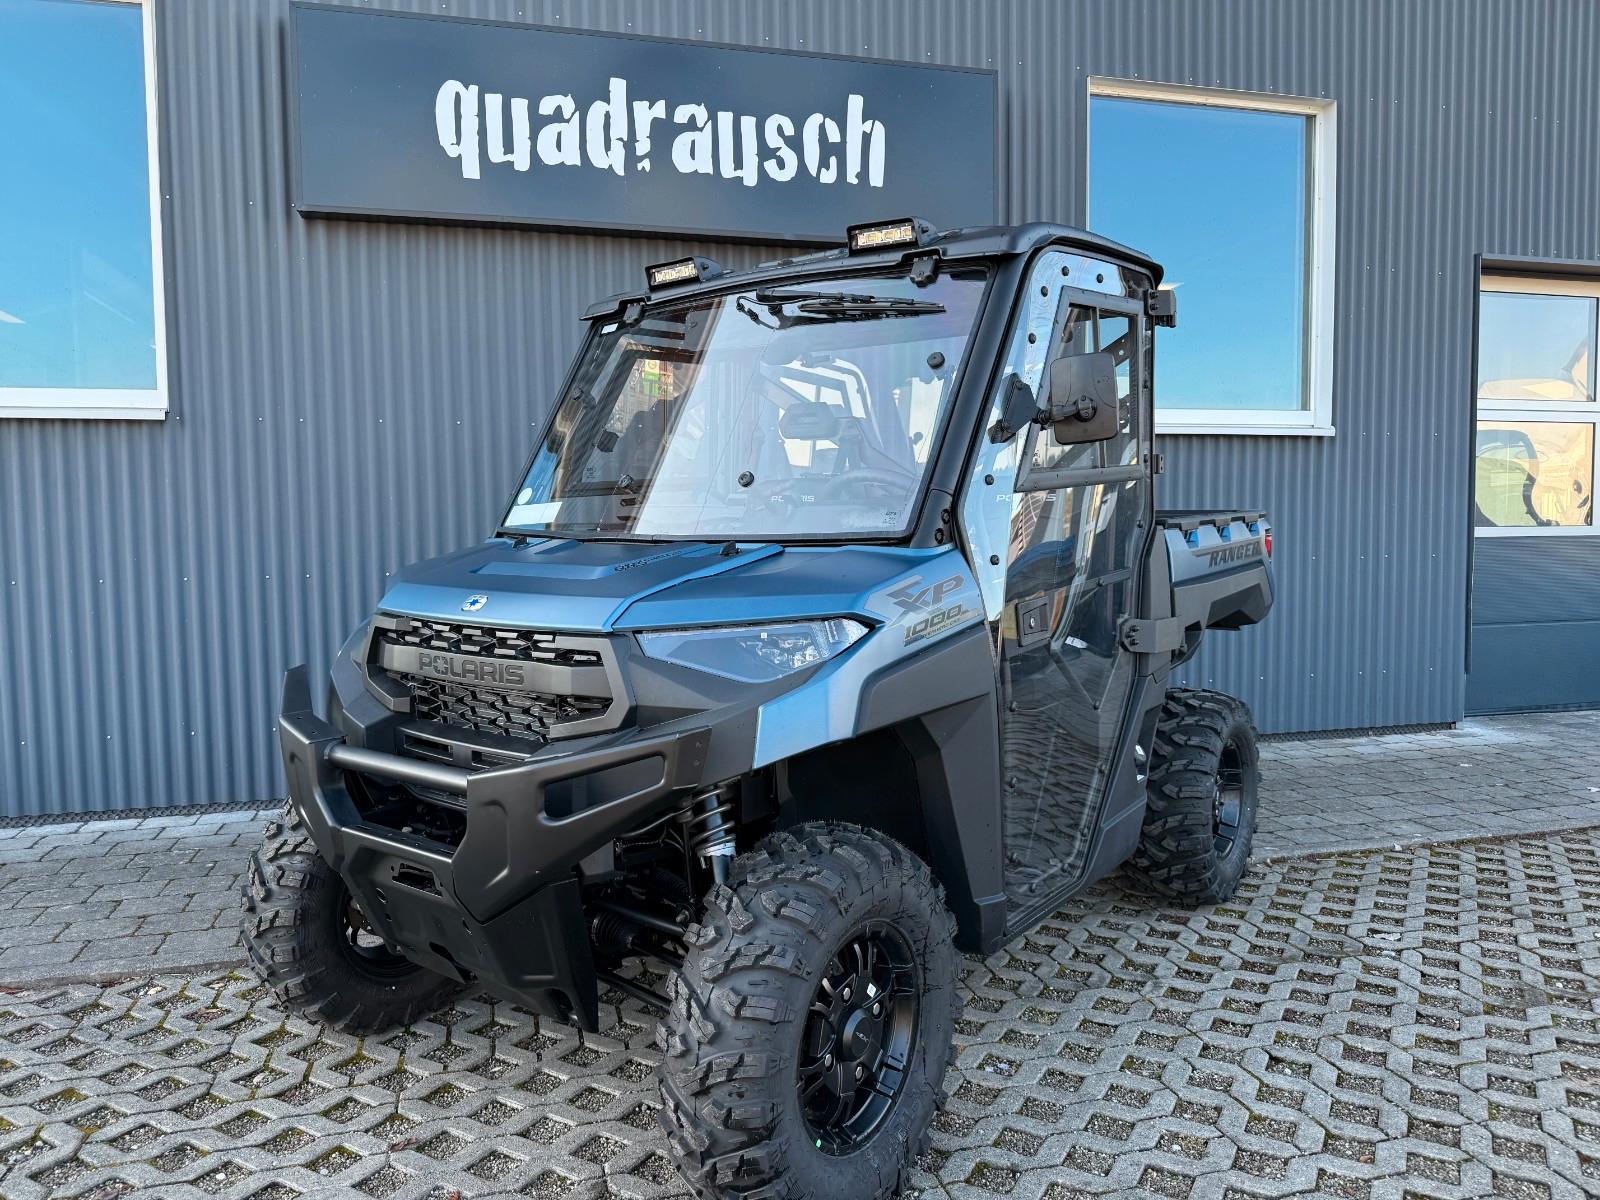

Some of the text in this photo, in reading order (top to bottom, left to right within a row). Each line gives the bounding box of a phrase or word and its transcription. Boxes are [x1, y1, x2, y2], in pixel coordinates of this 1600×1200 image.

[435, 77, 886, 187] quadrausch
[1208, 540, 1262, 568] RANGER
[886, 575, 964, 616] XP
[904, 603, 962, 639] 1000
[418, 652, 525, 686] POLARIS
